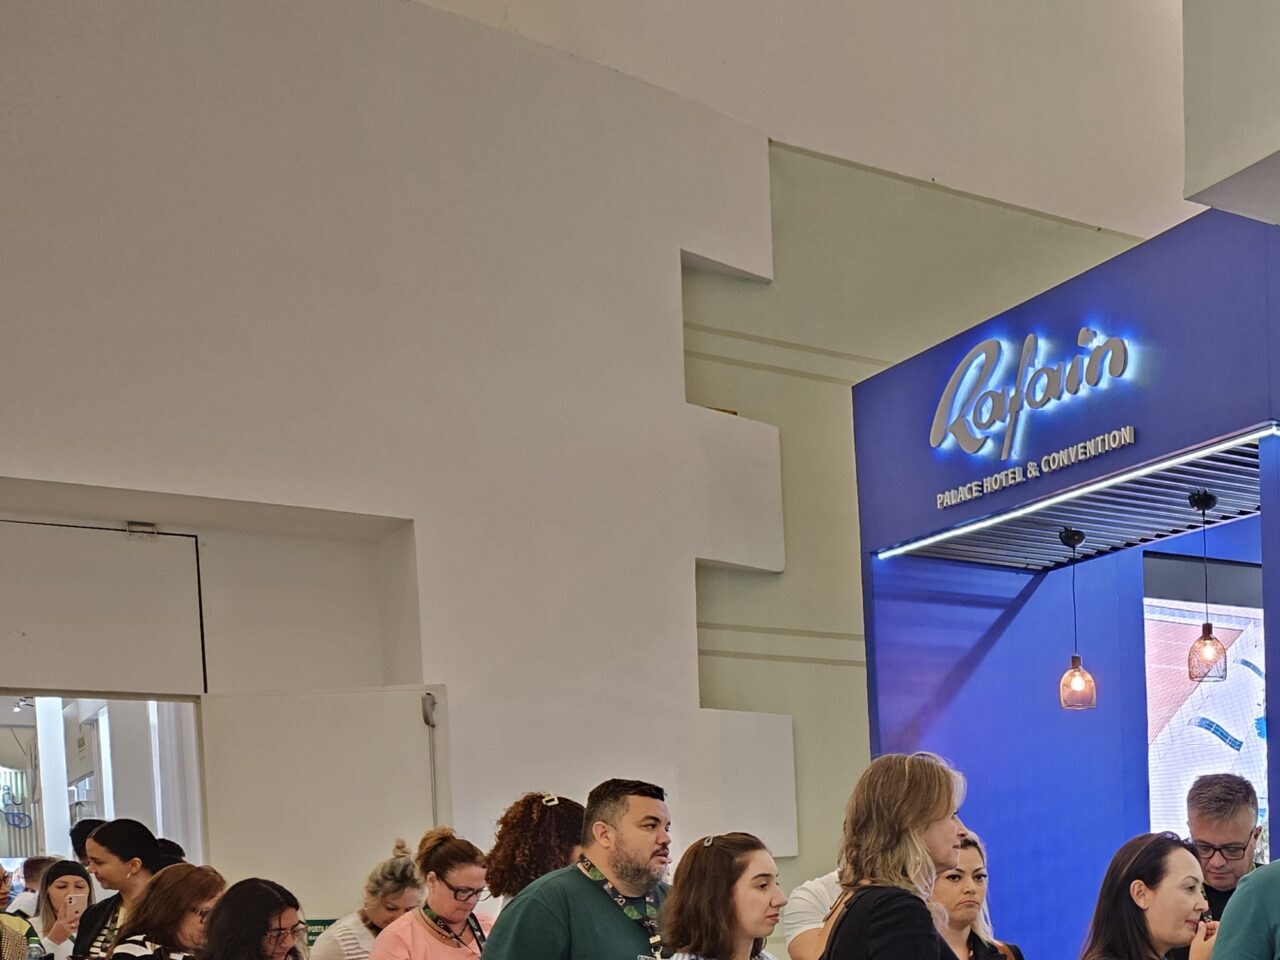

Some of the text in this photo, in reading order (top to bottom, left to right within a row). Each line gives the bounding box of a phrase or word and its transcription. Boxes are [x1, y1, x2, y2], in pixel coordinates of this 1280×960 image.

[929, 327, 1129, 460] Rafain
[937, 425, 1135, 509] PALACE HOTEL & CONVENTION
